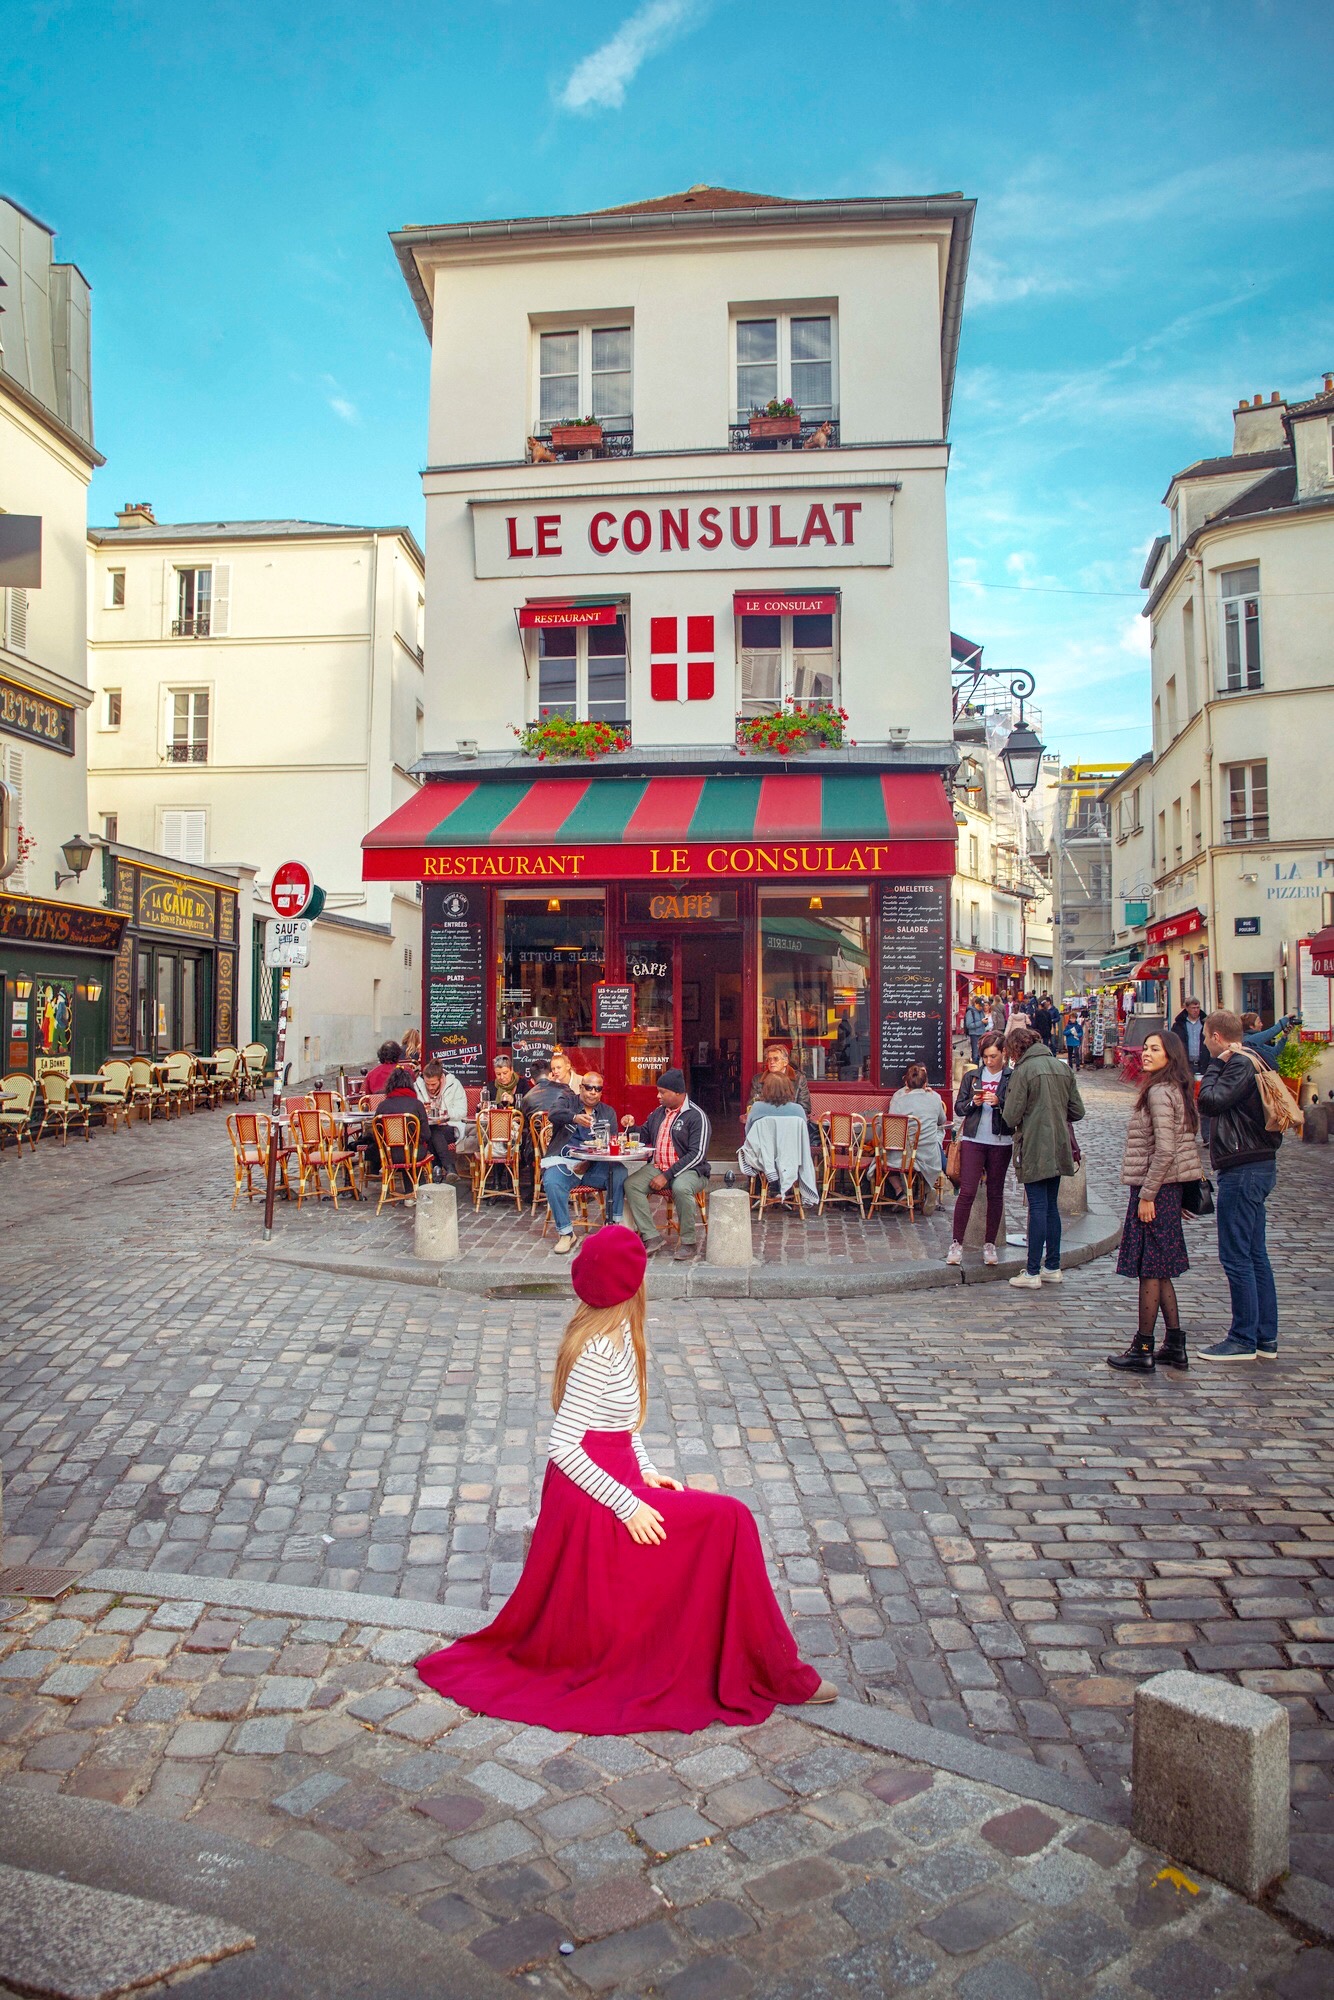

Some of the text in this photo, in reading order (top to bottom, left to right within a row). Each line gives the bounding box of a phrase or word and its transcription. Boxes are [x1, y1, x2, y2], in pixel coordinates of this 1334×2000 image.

[505, 502, 862, 560] LE CONSULAT
[746, 600, 823, 611] LE CONSULAT
[534, 612, 601, 624] RESTAURANT
[423, 846, 889, 876] RESTAURANT LE CONSULAT
[1274, 861, 1334, 880] LA P
[894, 885, 934, 893] OMELETTES
[152, 893, 161, 908] LA
[163, 892, 194, 918] CAVE
[196, 902, 205, 918] DE
[648, 891, 712, 919] CAFÉ
[25, 906, 71, 940] VINS
[151, 911, 160, 922] LA
[160, 912, 175, 925] BONNE
[275, 923, 299, 934] SAUF
[898, 1010, 926, 1018] CRÊPES
[513, 1020, 553, 1031] VIN CHAUD
[459, 1046, 478, 1055] MIXTE
[525, 1067, 531, 1078] 5
